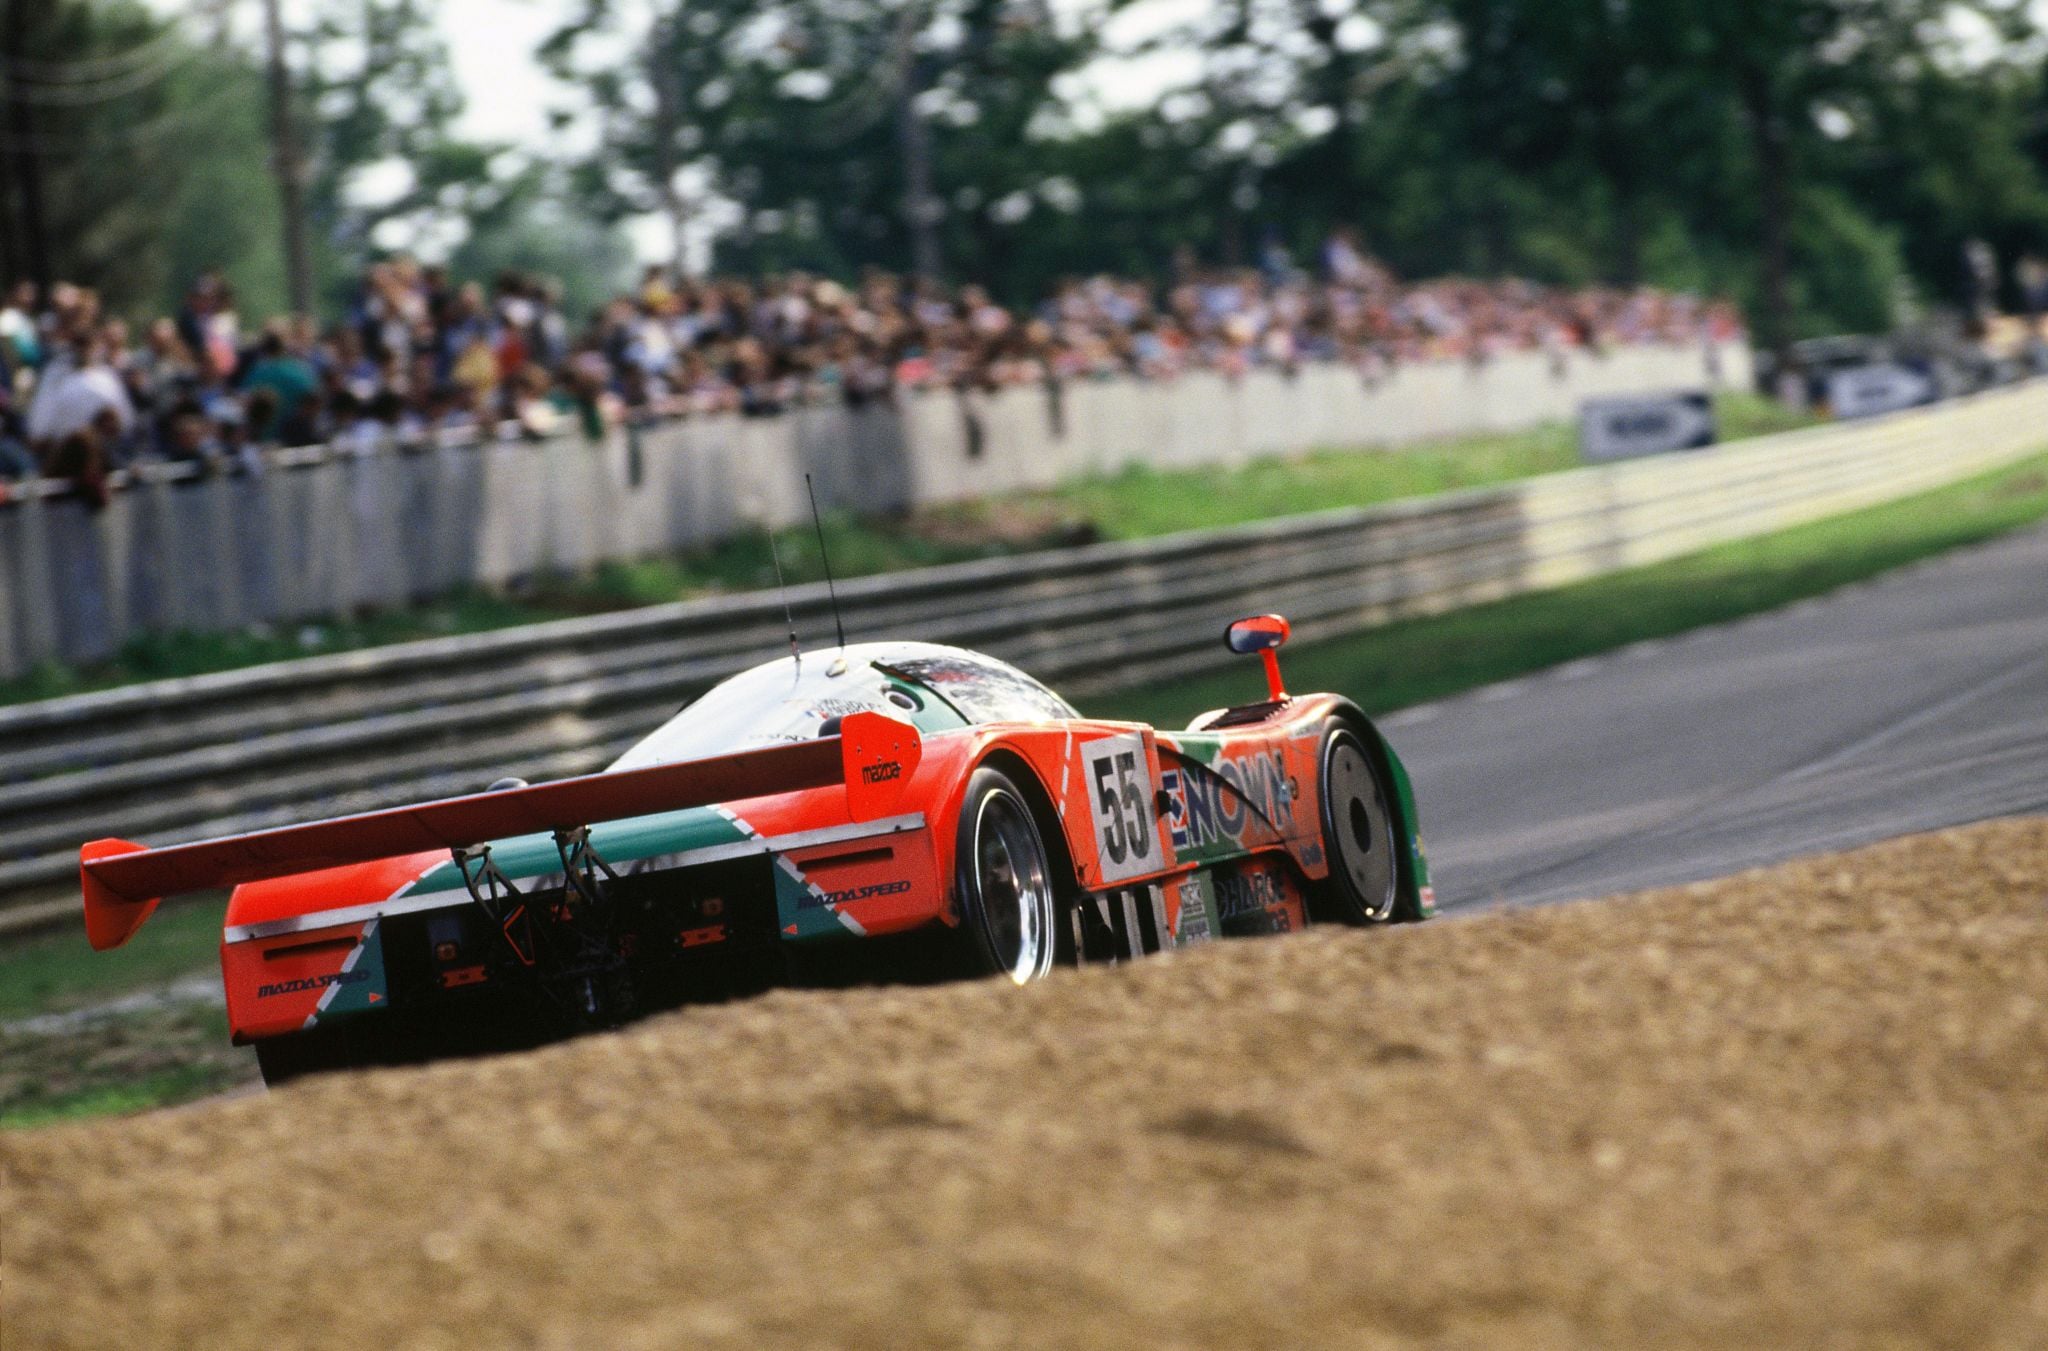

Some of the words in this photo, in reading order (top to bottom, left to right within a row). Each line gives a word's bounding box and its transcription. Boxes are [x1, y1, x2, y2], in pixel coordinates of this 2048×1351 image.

[862, 760, 902, 785] mazda
[1093, 751, 1149, 865] 55
[797, 880, 911, 909] MAZDASPEED
[258, 970, 370, 997] MAZDASPEED
